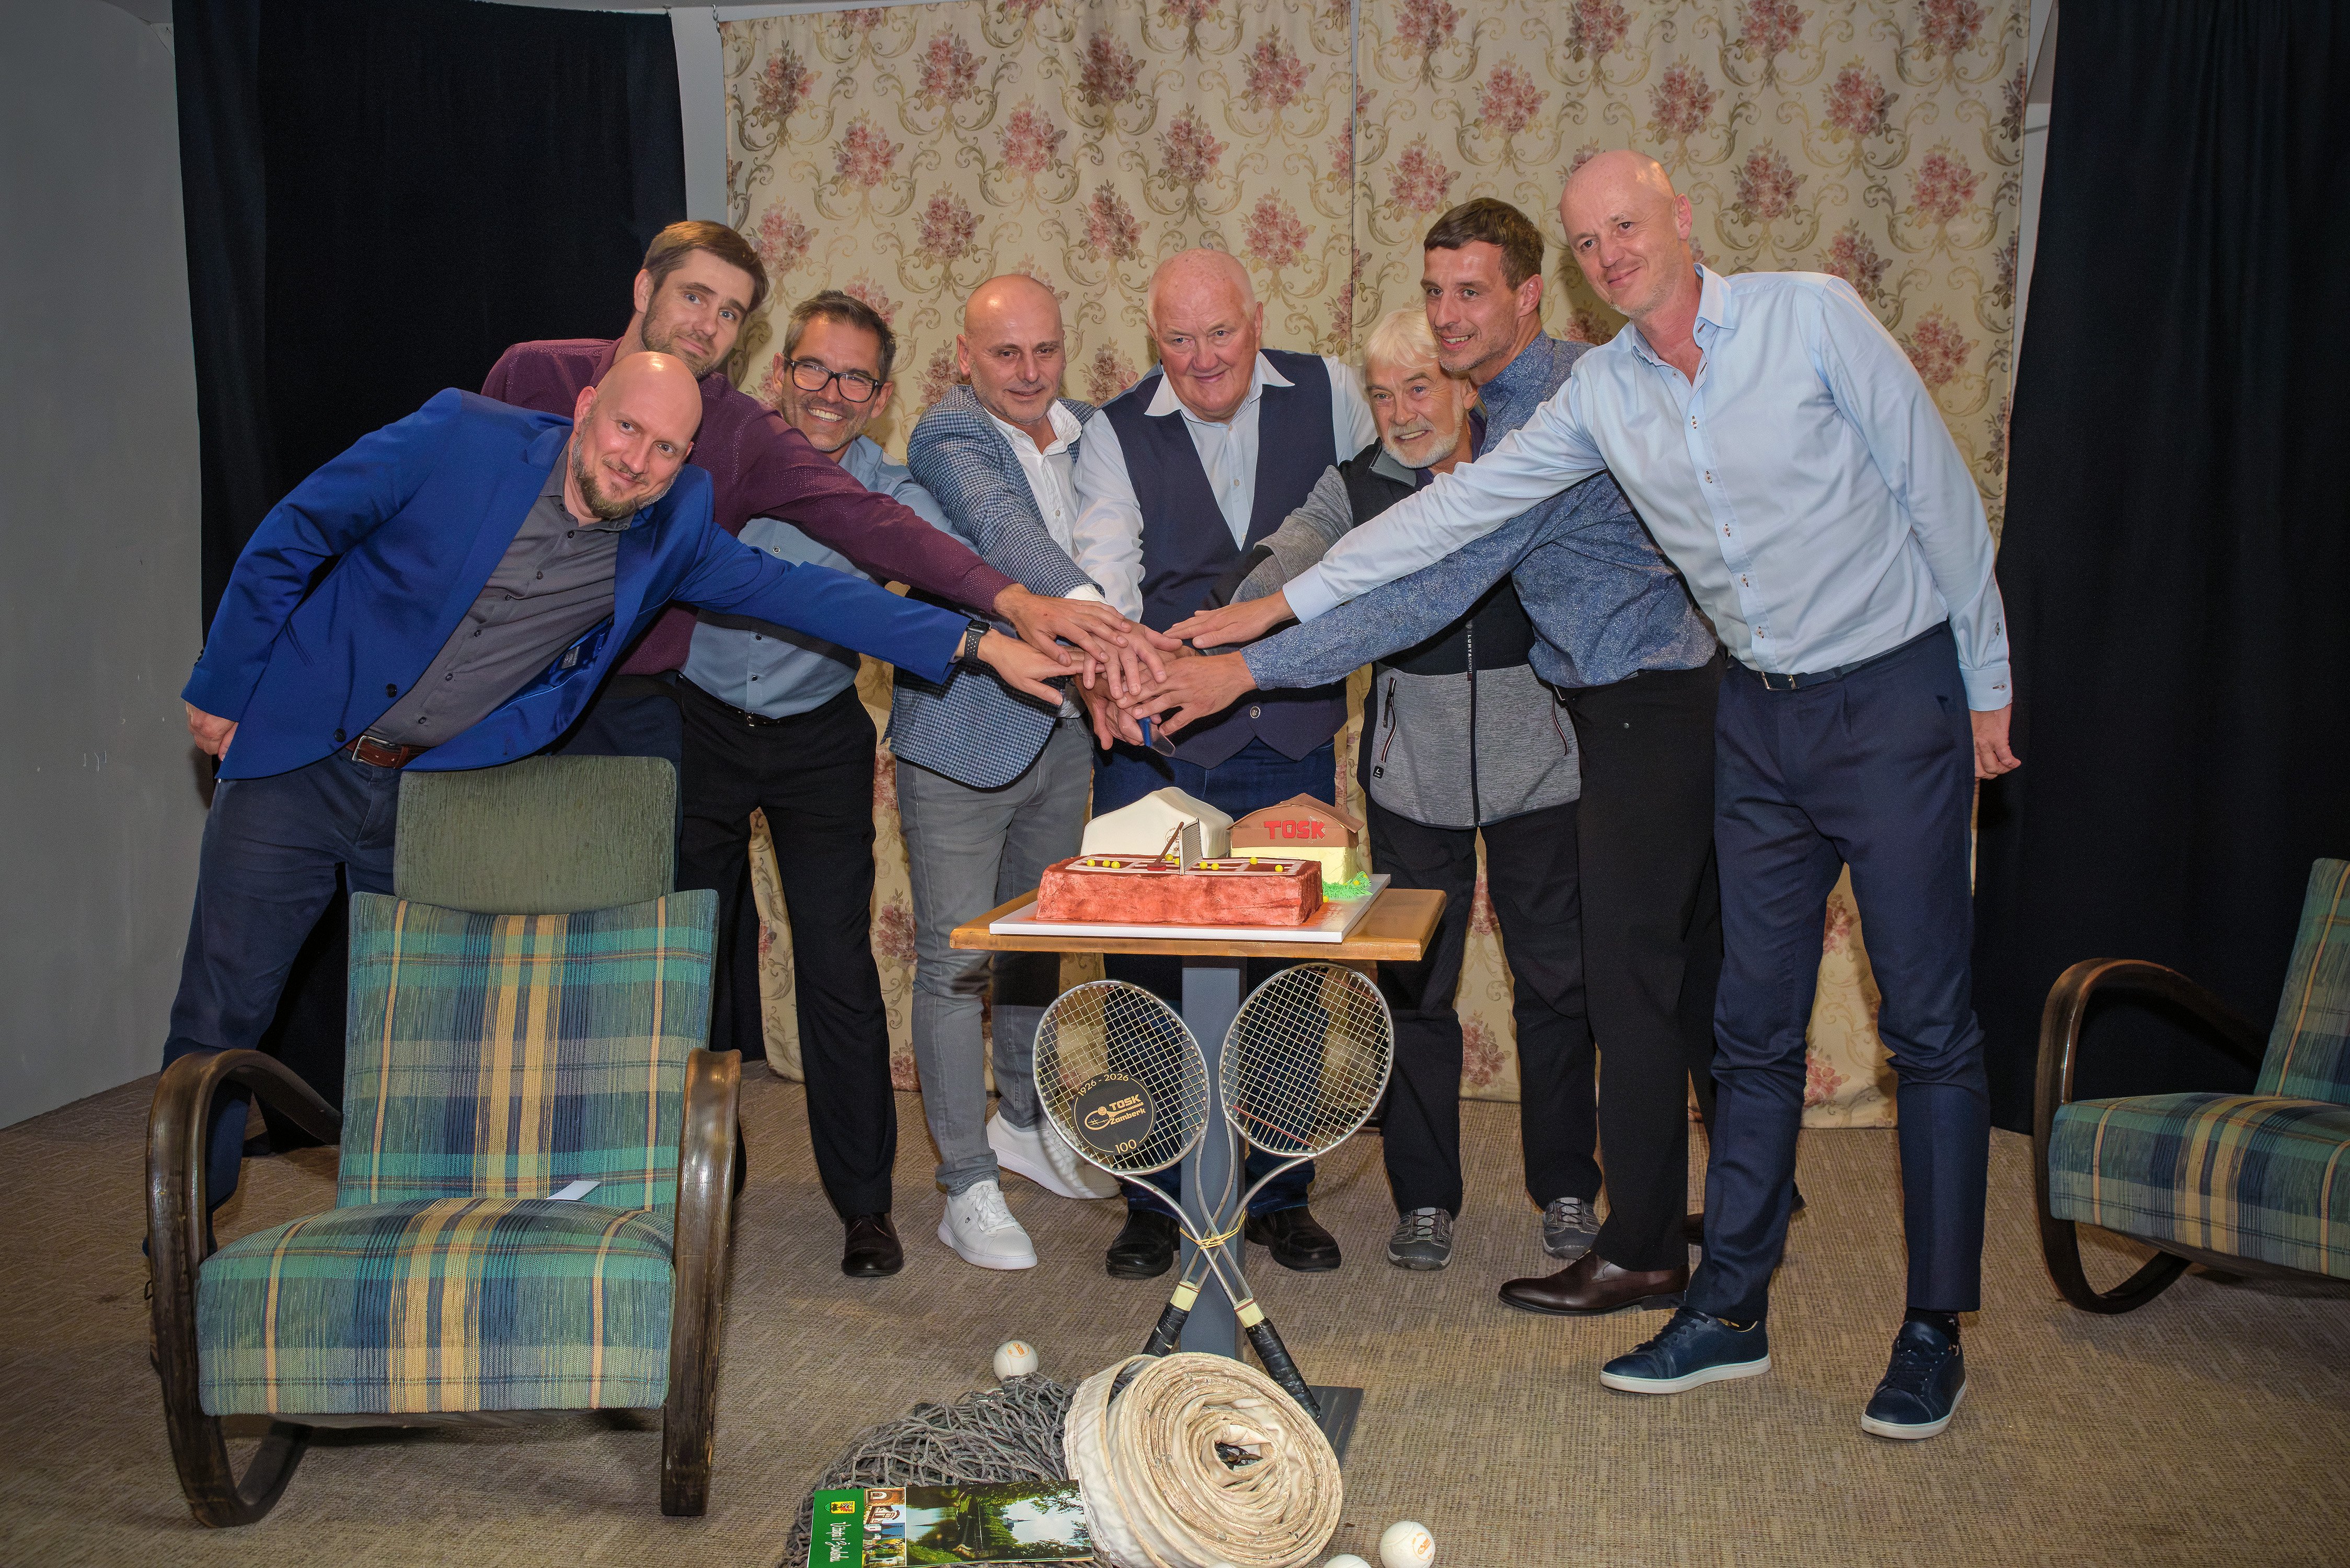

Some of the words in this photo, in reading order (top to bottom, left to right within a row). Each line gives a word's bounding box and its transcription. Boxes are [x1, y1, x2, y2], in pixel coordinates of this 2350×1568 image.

[1264, 820, 1326, 840] TOSK
[1078, 1079, 1097, 1096] 1926
[1104, 1073, 1129, 1081] 2026
[1109, 1094, 1141, 1111] TOSK
[1115, 1139, 1137, 1154] 100
